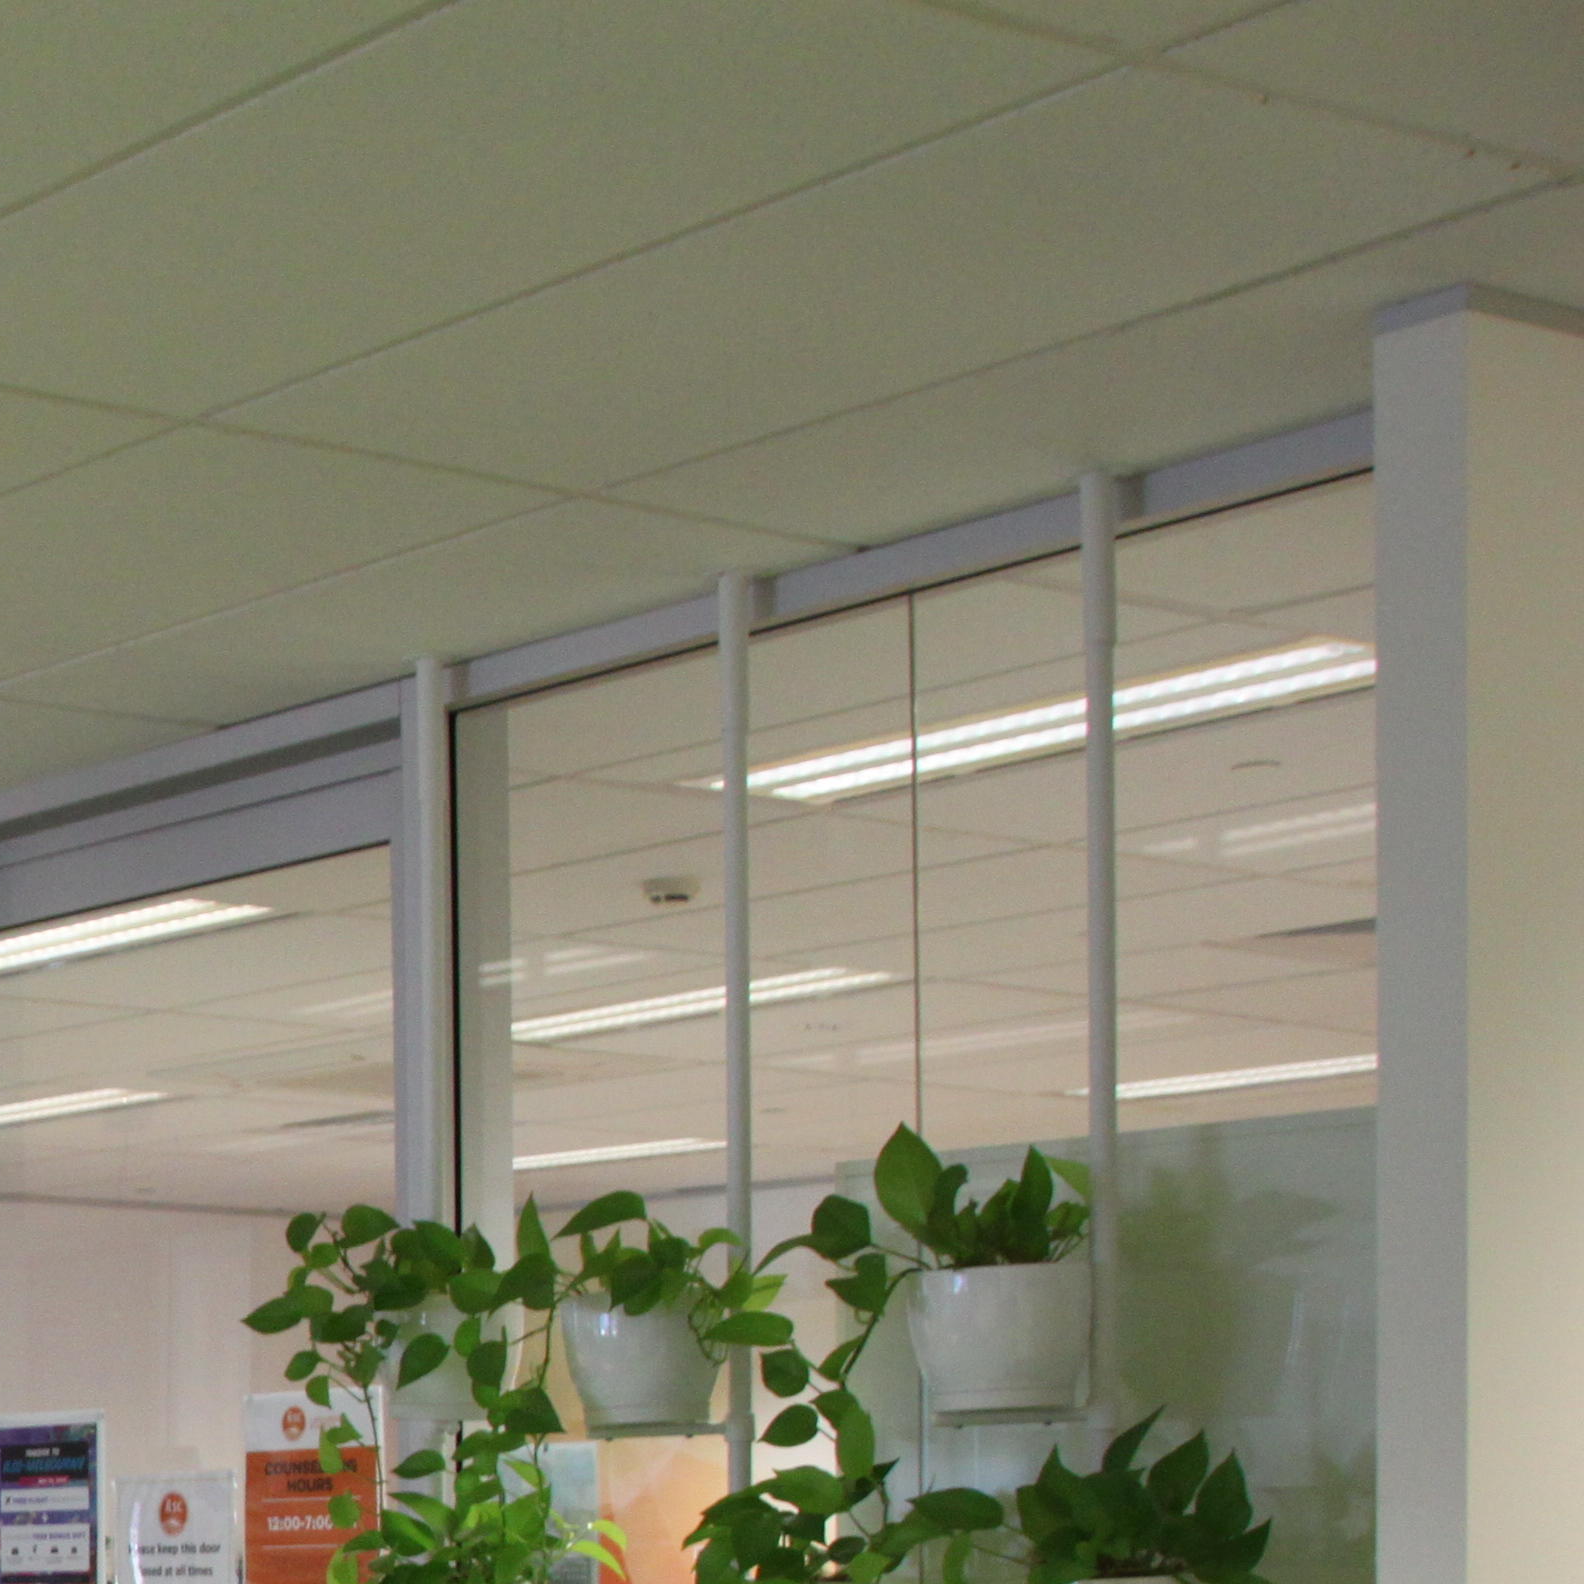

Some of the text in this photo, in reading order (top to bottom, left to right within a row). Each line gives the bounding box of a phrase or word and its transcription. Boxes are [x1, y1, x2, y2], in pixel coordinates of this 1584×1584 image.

[288, 1477, 333, 1492] HOURS
[158, 1544, 178, 1555] keep
[181, 1543, 197, 1554] this
[199, 1542, 221, 1554] door
[188, 1565, 213, 1576] times
